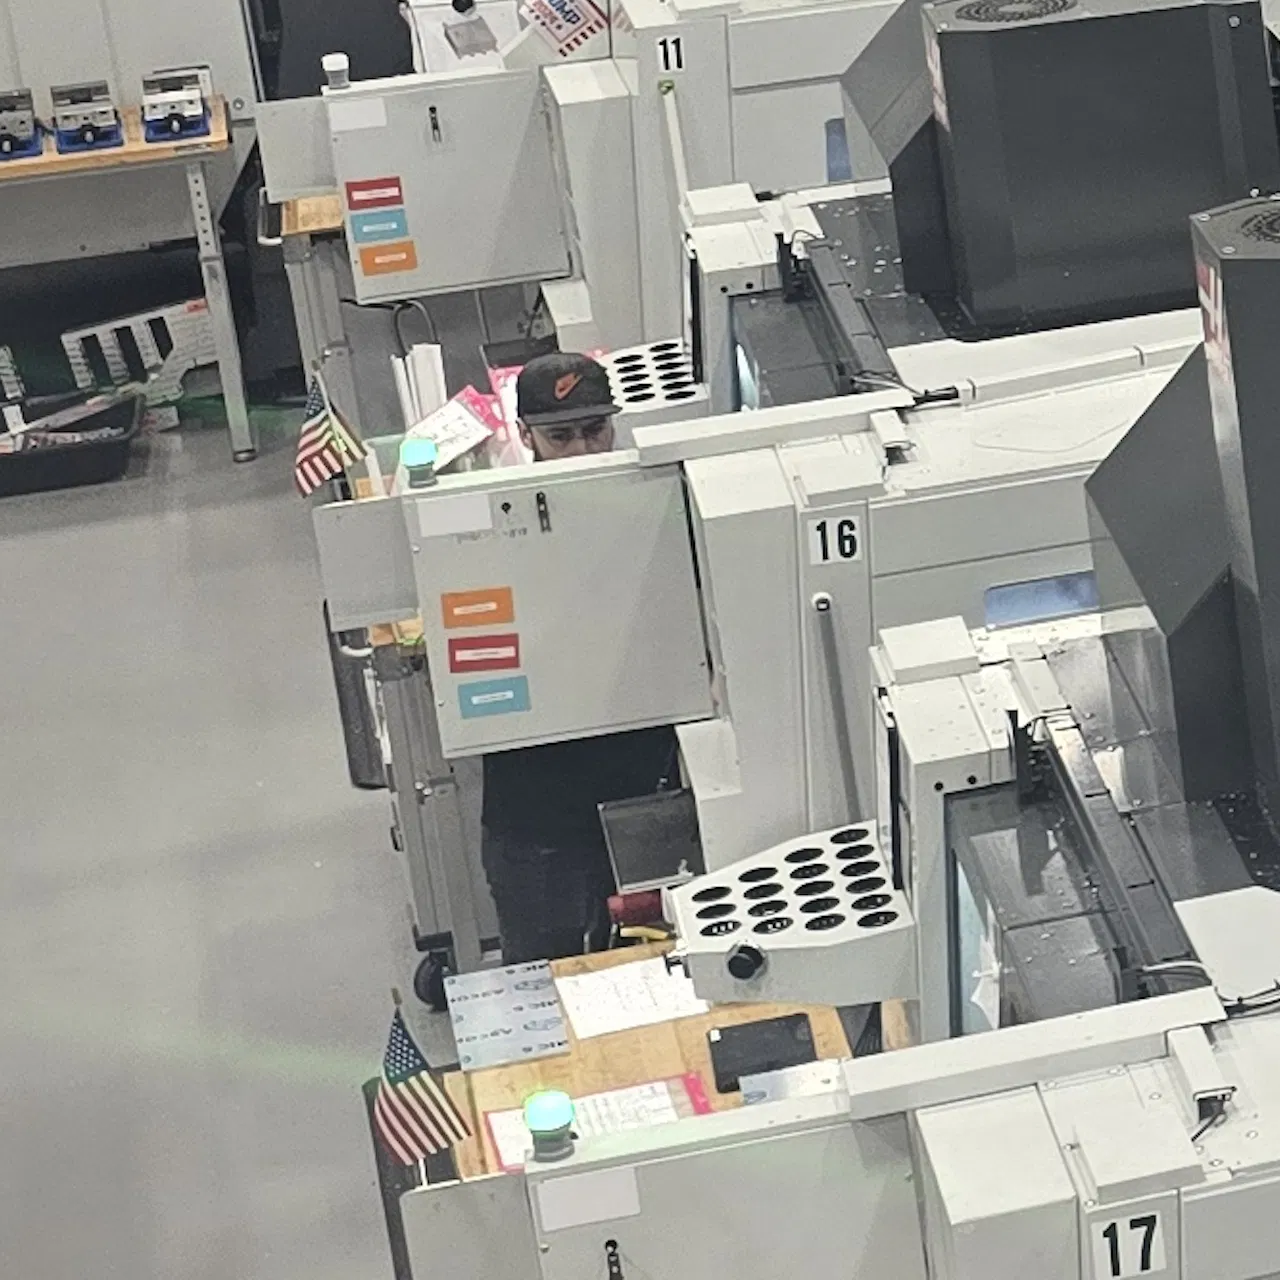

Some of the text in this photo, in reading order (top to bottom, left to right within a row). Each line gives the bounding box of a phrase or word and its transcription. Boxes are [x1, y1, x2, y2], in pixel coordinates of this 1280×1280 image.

[658, 37, 683, 71] 11
[815, 519, 857, 561] 16
[1102, 1214, 1157, 1277] 17
